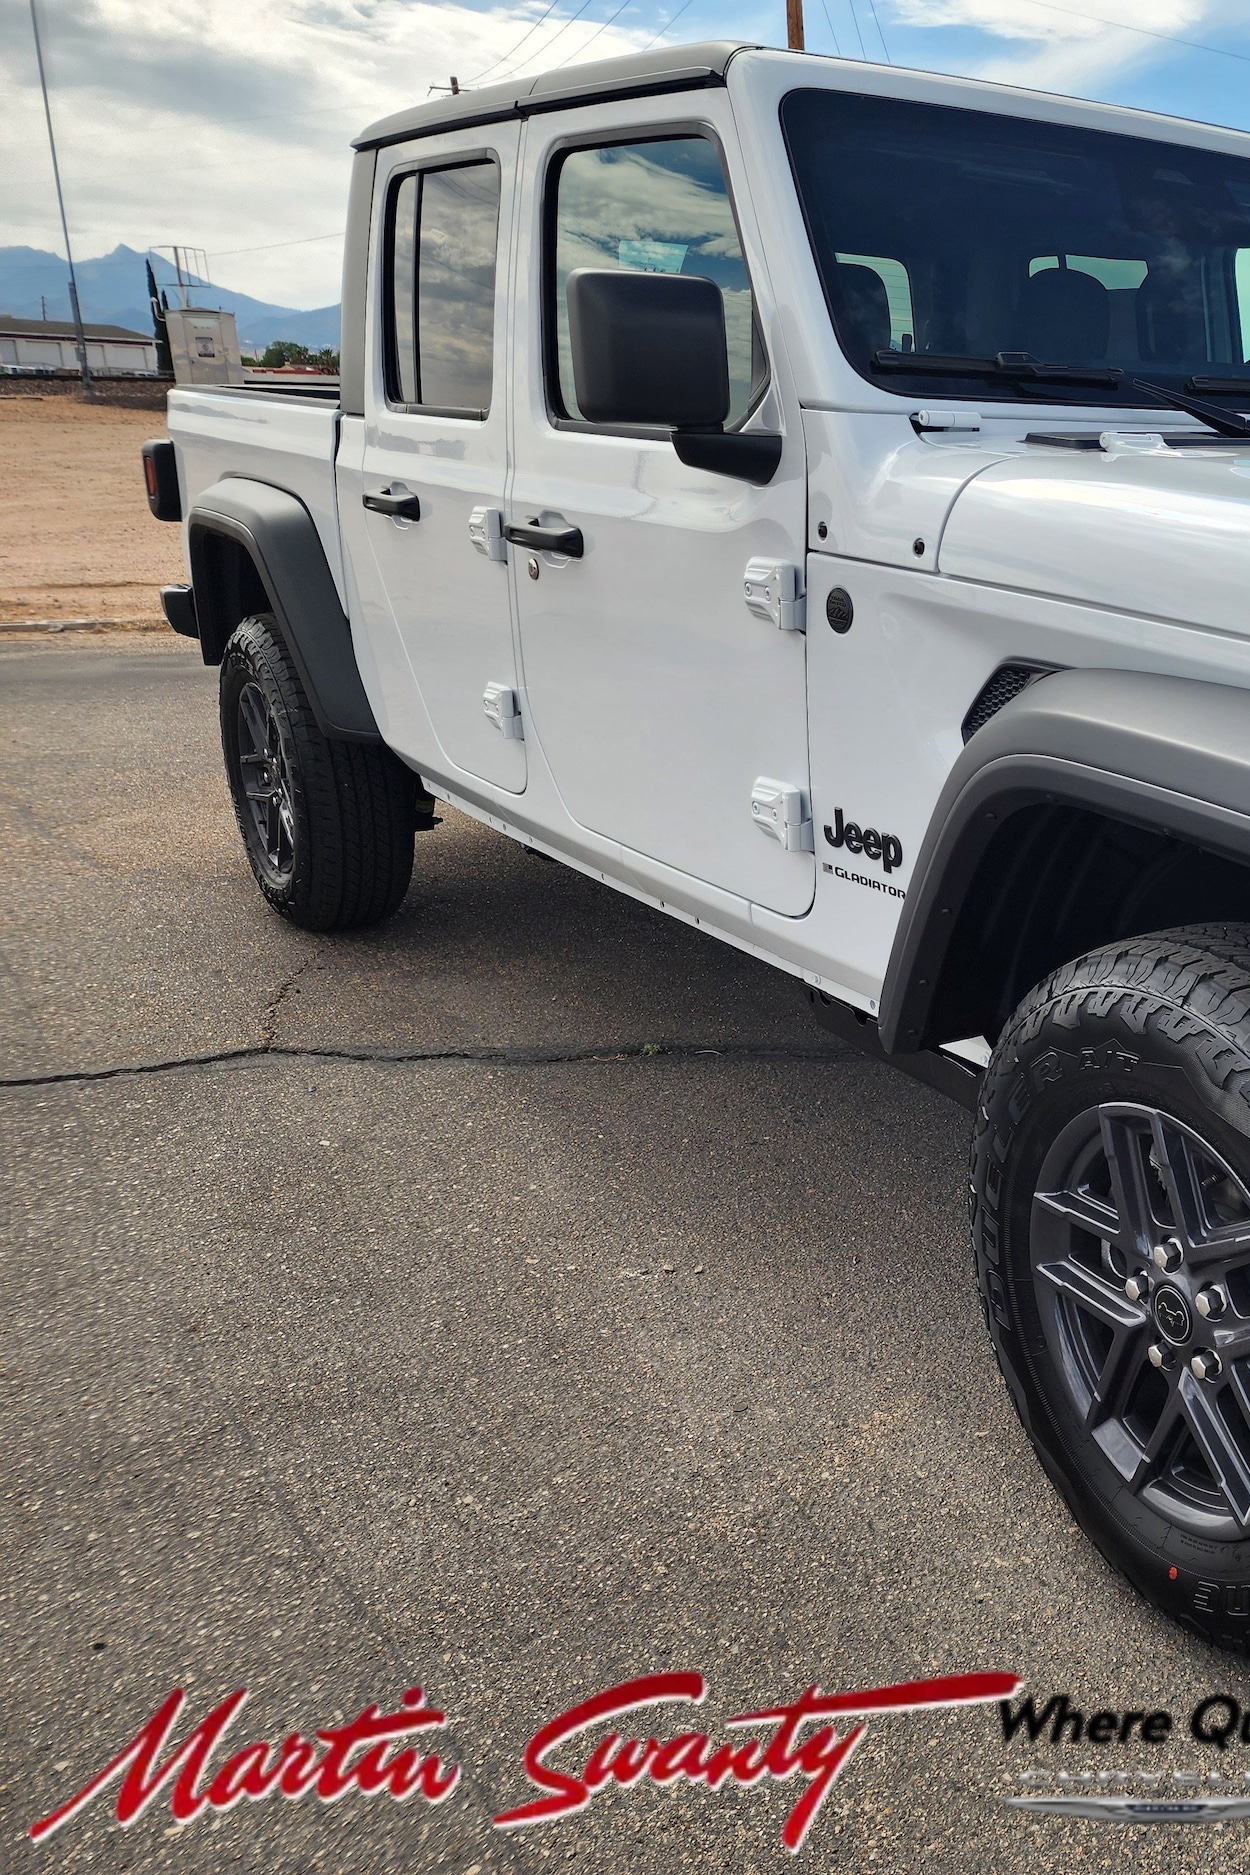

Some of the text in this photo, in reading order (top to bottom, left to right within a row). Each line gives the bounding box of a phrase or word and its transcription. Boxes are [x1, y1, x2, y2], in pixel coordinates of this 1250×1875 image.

[823, 806, 903, 874] Jeep
[834, 866, 906, 900] GLADIATOR
[980, 1049, 1065, 1333] DUELER
[1078, 1046, 1142, 1073] A/T
